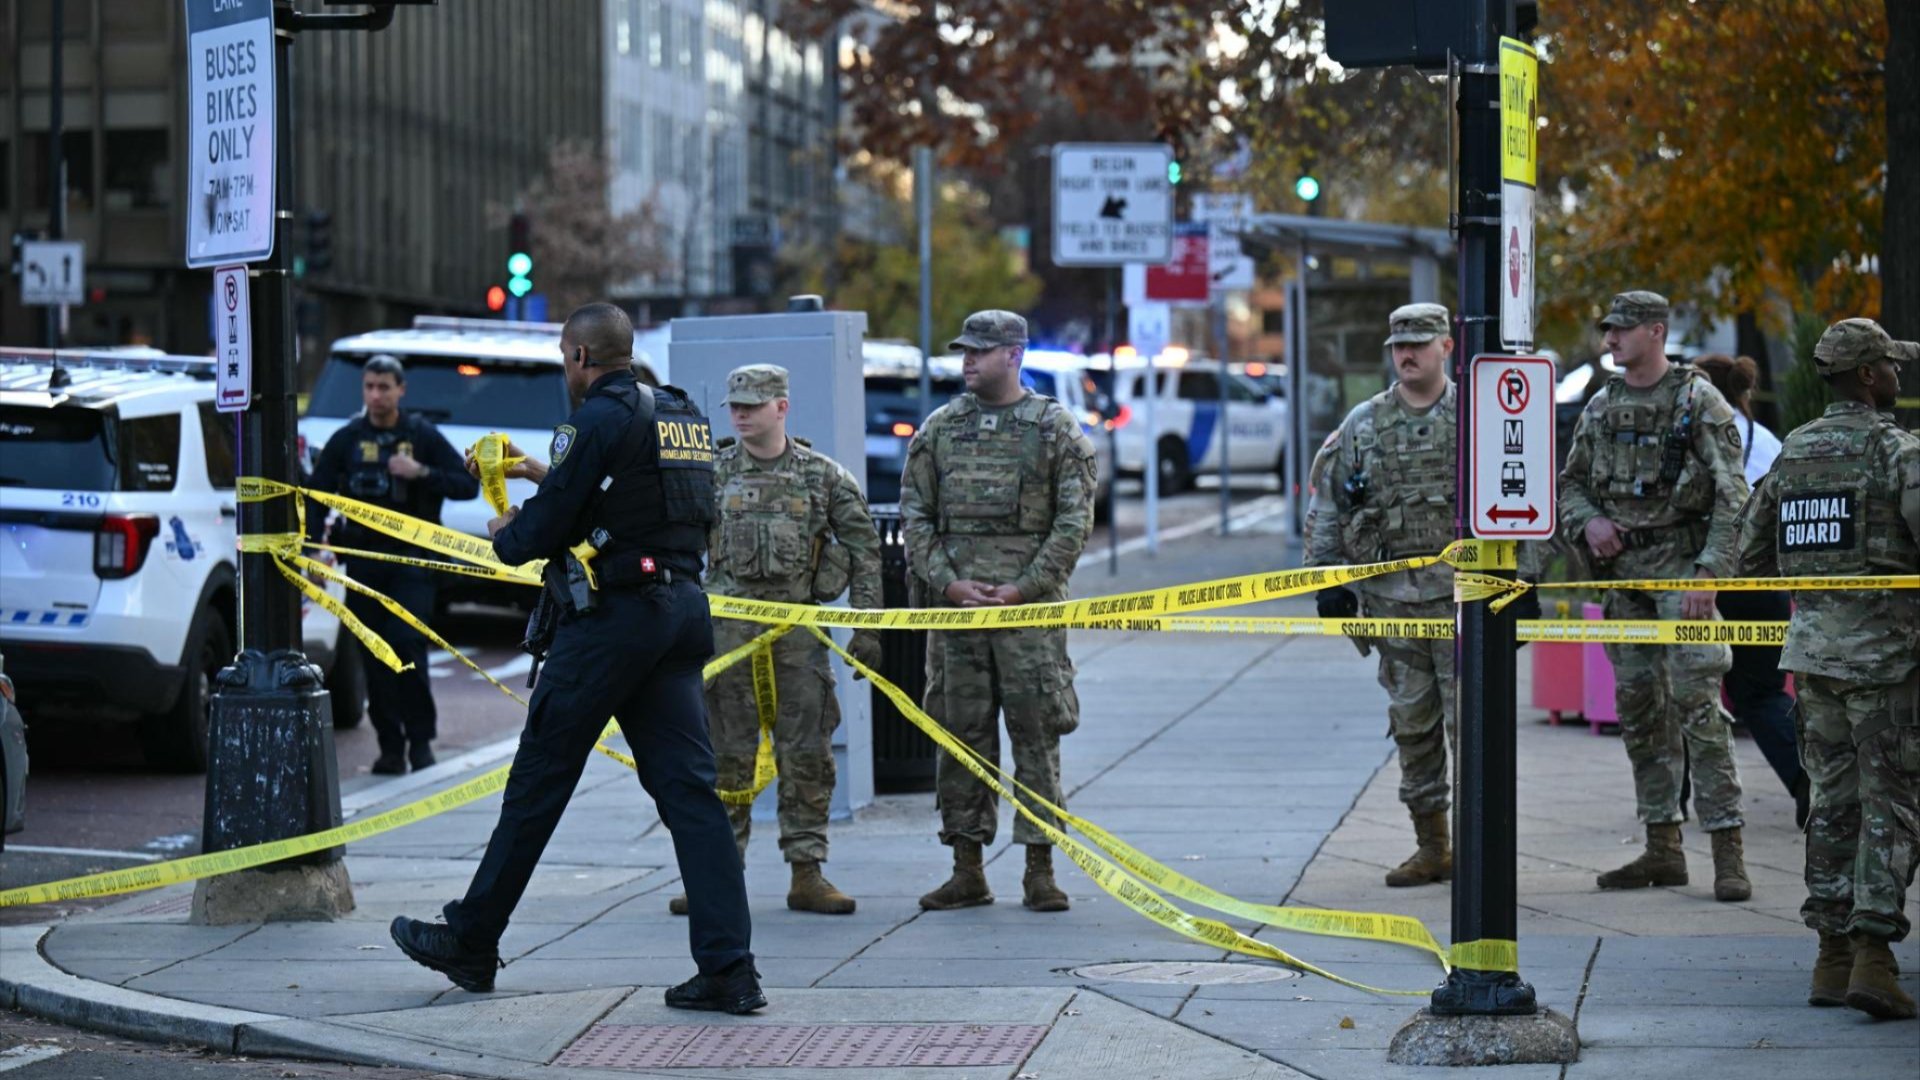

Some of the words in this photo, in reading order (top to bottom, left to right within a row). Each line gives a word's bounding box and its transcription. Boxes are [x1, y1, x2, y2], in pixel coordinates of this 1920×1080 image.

[205, 39, 256, 82] BUSES
[207, 83, 257, 125] BIKES
[209, 124, 255, 164] ONLY
[657, 421, 712, 450] POLICE
[660, 449, 692, 460] HOMELAND
[62, 492, 100, 507] 210
[1781, 497, 1850, 522] NATIONAL
[431, 530, 453, 548] POLICE
[451, 537, 466, 552] LINE
[465, 541, 476, 554] DO
[1786, 522, 1841, 546] GUARD
[1264, 576, 1281, 593] POLICE
[1281, 574, 1293, 589] LINE
[1178, 589, 1196, 606] POLICE
[1196, 587, 1208, 603] LINE
[1208, 586, 1215, 602] DO
[1215, 584, 1226, 600] NOT
[1226, 582, 1242, 599] CROSS
[751, 604, 763, 616] DO
[760, 606, 775, 616] NOT
[771, 607, 791, 619] CROSS
[1088, 600, 1108, 615] POLICE
[1106, 599, 1119, 613] LINE
[1118, 598, 1127, 612] DO
[1126, 596, 1138, 611] NOT
[1137, 594, 1155, 610] CROSS
[814, 610, 838, 622] POLICE
[832, 611, 848, 622] LINE
[844, 611, 856, 623] DO
[852, 612, 867, 623] NOT
[863, 612, 885, 624] CROSS
[906, 612, 928, 624] POLICE
[924, 612, 940, 624] LINE
[937, 612, 947, 624] DO
[945, 611, 959, 624] NOT
[955, 611, 976, 624] CROSS
[998, 608, 1018, 621] POLICE
[1015, 608, 1031, 620] LINE
[1027, 607, 1038, 620] DO
[1036, 606, 1049, 619] NOT
[1046, 605, 1066, 619] CROSS
[1127, 619, 1161, 631] CRIME
[1341, 622, 1376, 636] CROSS
[1381, 623, 1399, 637] NOT
[1404, 623, 1418, 637] DO
[1675, 625, 1710, 641] CROSS
[1713, 625, 1734, 641] NOT
[1738, 625, 1752, 641] DO
